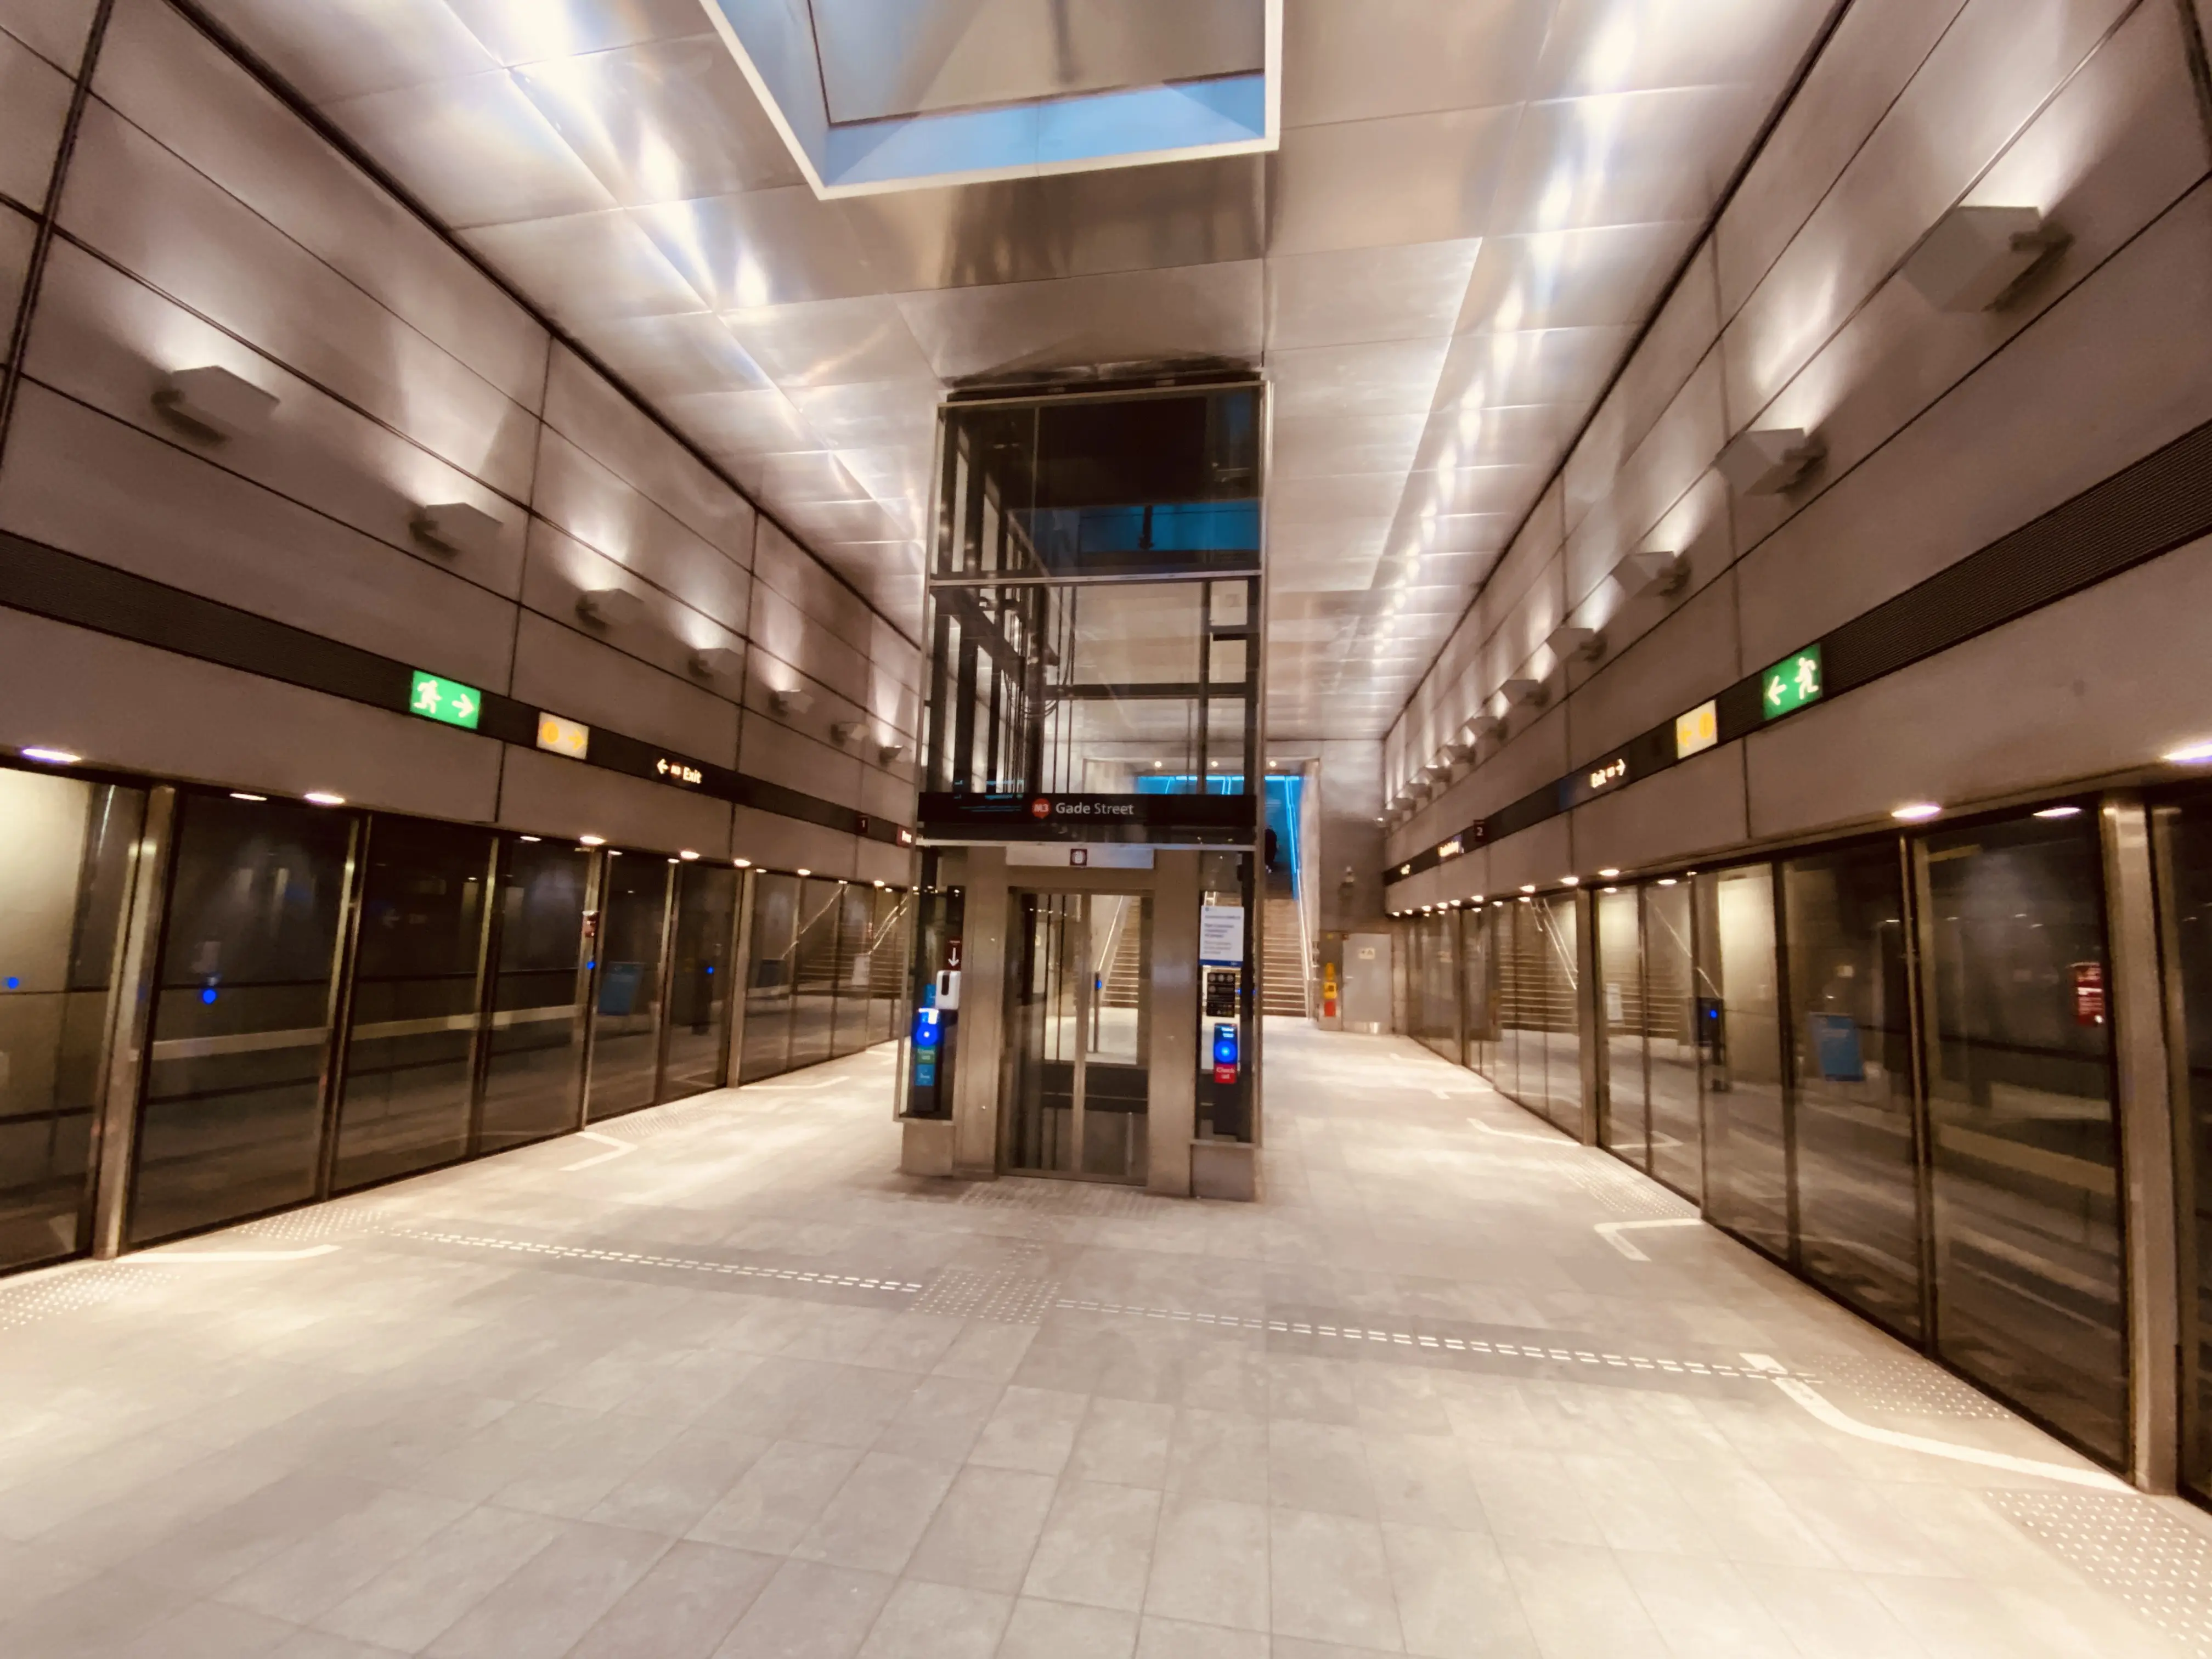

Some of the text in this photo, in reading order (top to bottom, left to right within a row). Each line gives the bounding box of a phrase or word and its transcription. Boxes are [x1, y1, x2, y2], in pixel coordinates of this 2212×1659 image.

[682, 766, 702, 784] Exit
[1033, 802, 1135, 815] M3 Gade Street
[1476, 826, 1483, 836] 2
